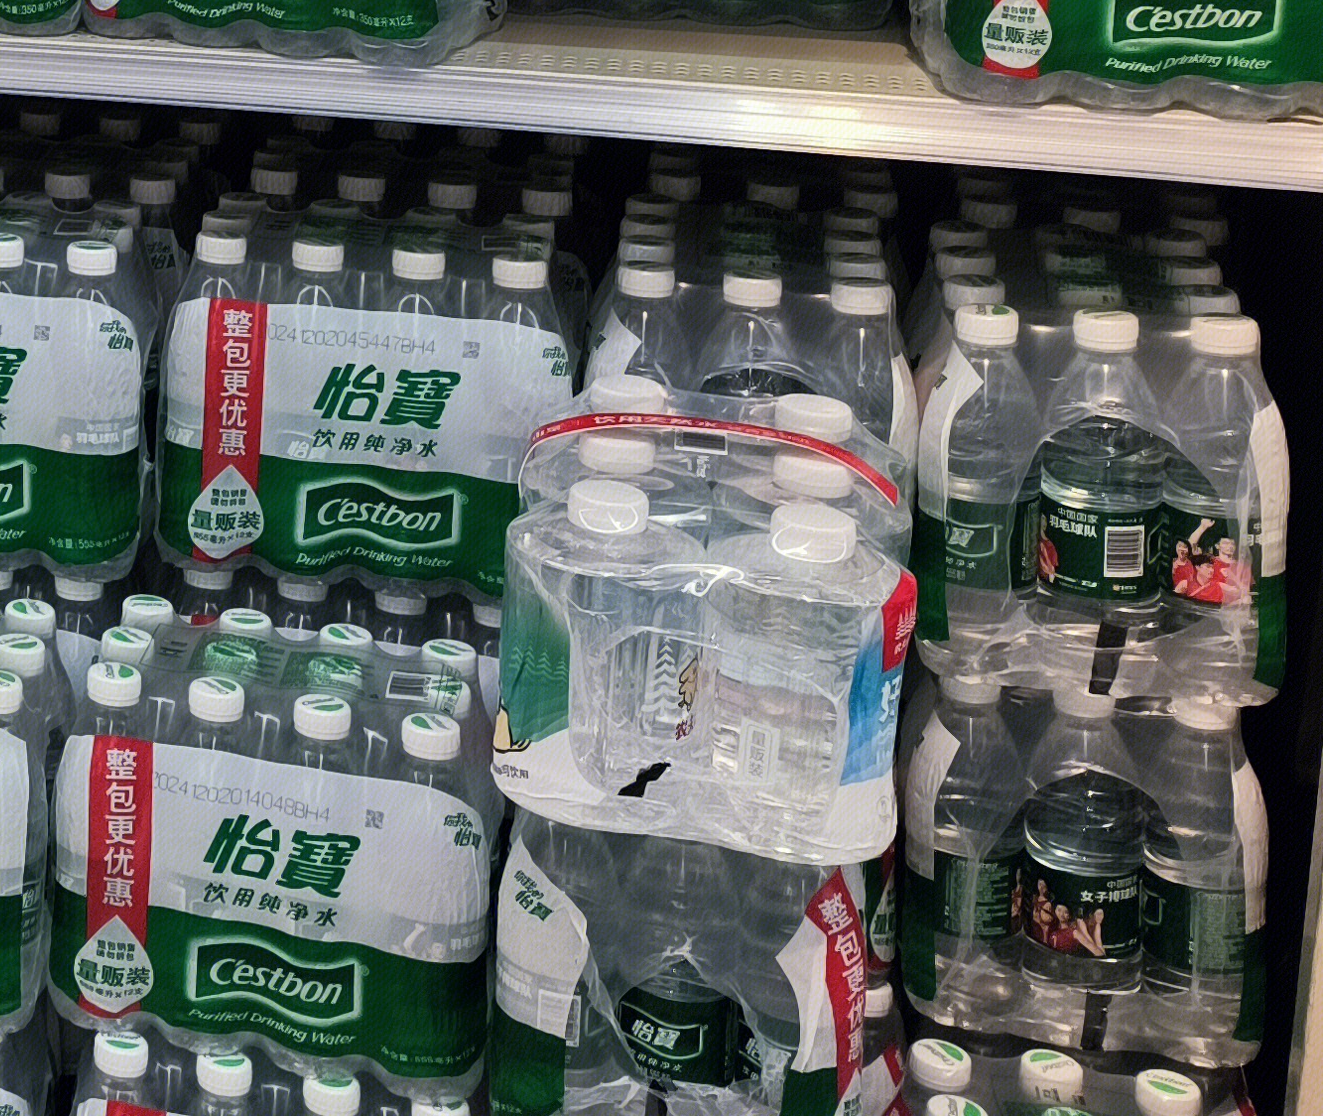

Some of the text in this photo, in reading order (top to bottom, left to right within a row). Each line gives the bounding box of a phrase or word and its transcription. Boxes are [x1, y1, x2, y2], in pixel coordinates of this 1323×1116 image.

[219, 308, 252, 456] 整包更优惠
[313, 364, 461, 430] 怡寶
[203, 814, 361, 898] 怡寶
[203, 883, 339, 928] 饮用纯净水
